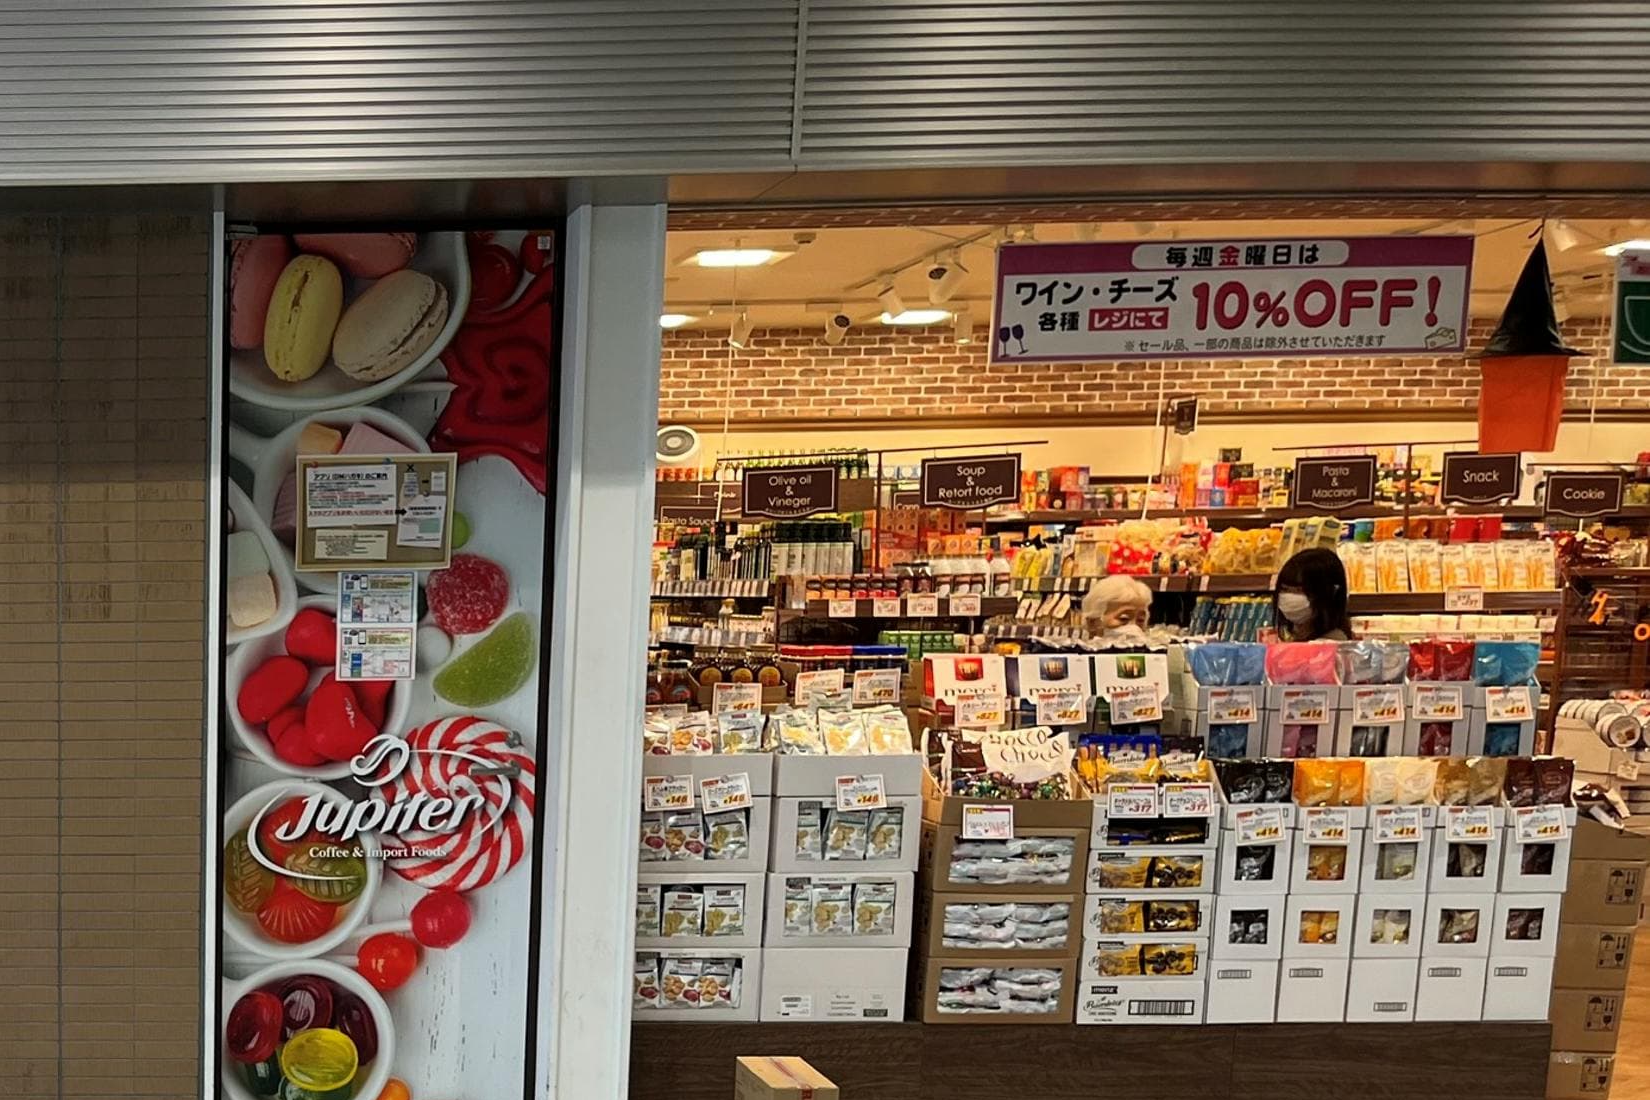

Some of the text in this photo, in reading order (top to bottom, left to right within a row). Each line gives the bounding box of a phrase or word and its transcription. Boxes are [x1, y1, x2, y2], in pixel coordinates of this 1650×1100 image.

[1165, 243, 1320, 268] 毎週金曜日は
[1015, 276, 1180, 306] ワイン・チーズ
[1038, 310, 1166, 332] 各種 レジにて
[956, 465, 986, 477] Soup
[1322, 465, 1350, 477] Pasta
[1462, 470, 1500, 483] Snack
[768, 475, 812, 487] Olive oil
[965, 476, 975, 487] &
[1330, 477, 1339, 487] &
[785, 486, 794, 497] &
[938, 485, 1003, 499] Retort food
[1311, 487, 1357, 499] Macaroni
[1562, 487, 1606, 500] Cookie
[274, 774, 485, 842] Jupiter
[309, 846, 447, 861] Coffee & Import Foods
